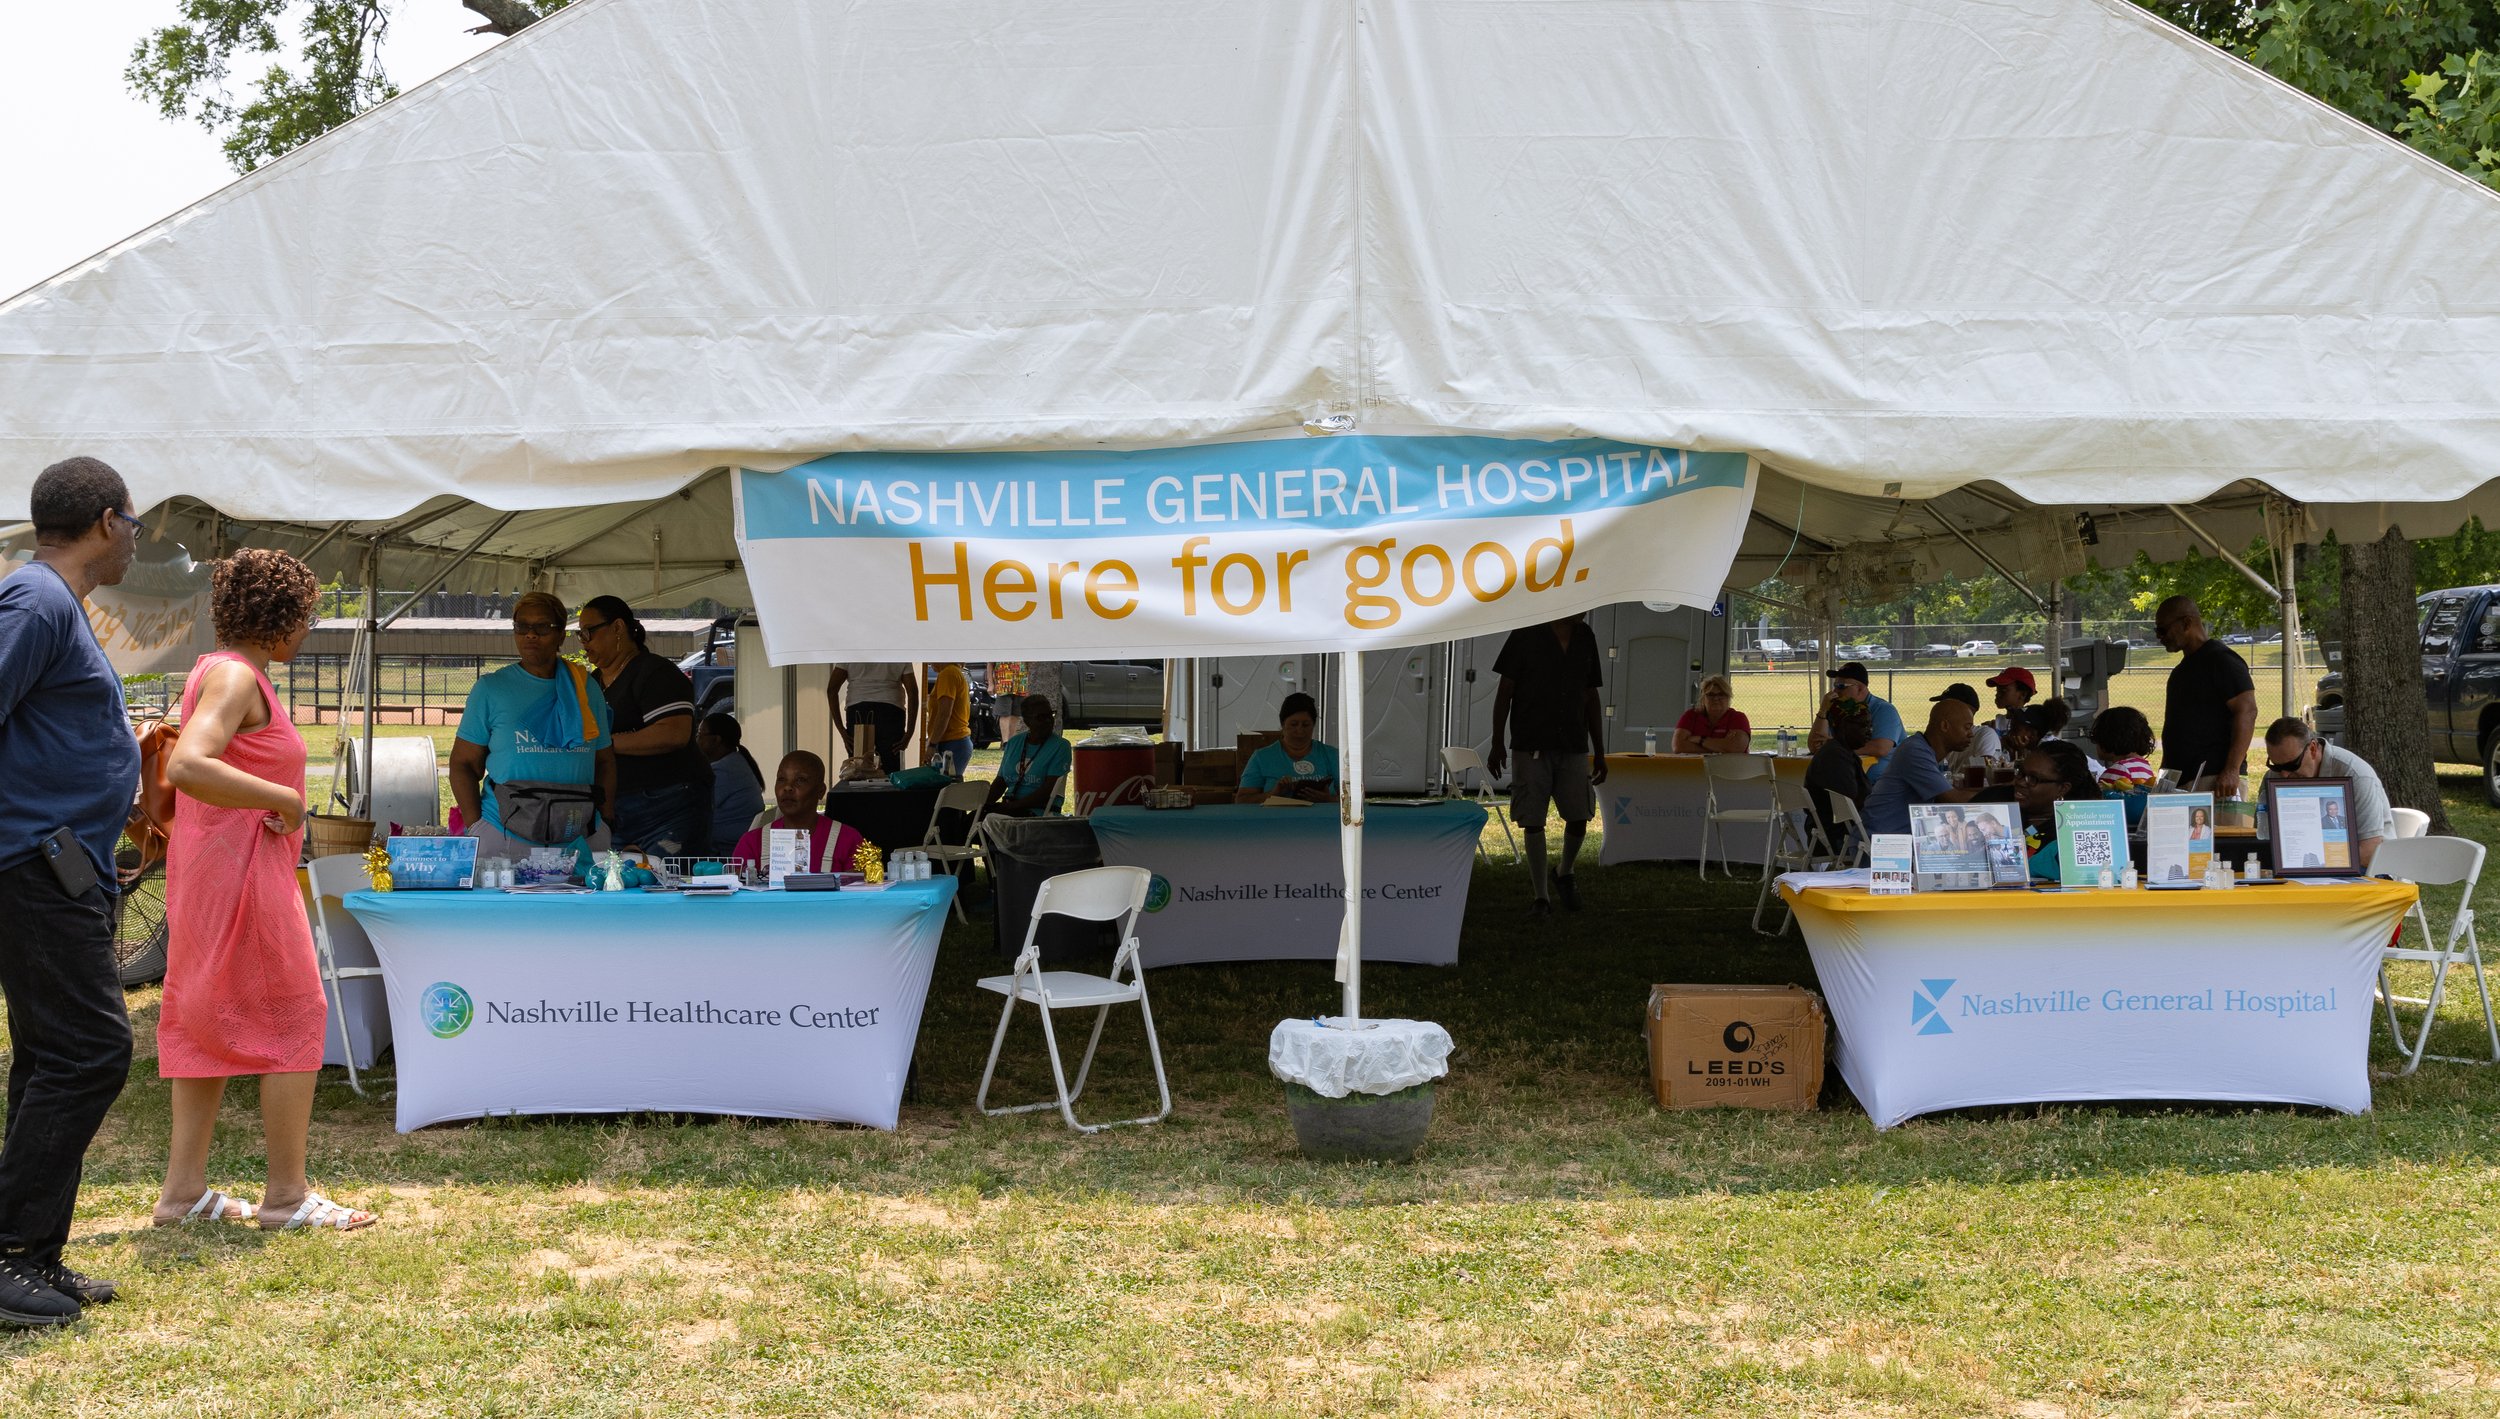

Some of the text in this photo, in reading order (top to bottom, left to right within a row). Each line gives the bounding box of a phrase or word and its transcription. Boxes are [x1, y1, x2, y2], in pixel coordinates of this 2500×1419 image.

[807, 477, 1128, 529] NASHVILLE
[1145, 461, 1419, 524] GENERAL
[1435, 448, 1699, 510] HOSPITAL
[909, 518, 1591, 631] Here for good.
[1634, 805, 1692, 818] Nashville
[2065, 811, 2115, 821] Schedule your
[2065, 819, 2115, 827] Appointment
[405, 862, 437, 874] Why
[1179, 883, 1442, 902] Nashville Healthcre Center
[1961, 987, 2338, 1019] Nashville General Hospital
[485, 999, 880, 1029] Nashville Healthcare Center
[1688, 1060, 1786, 1076] LEED'S
[1705, 1077, 1771, 1088] 2091-01WH
